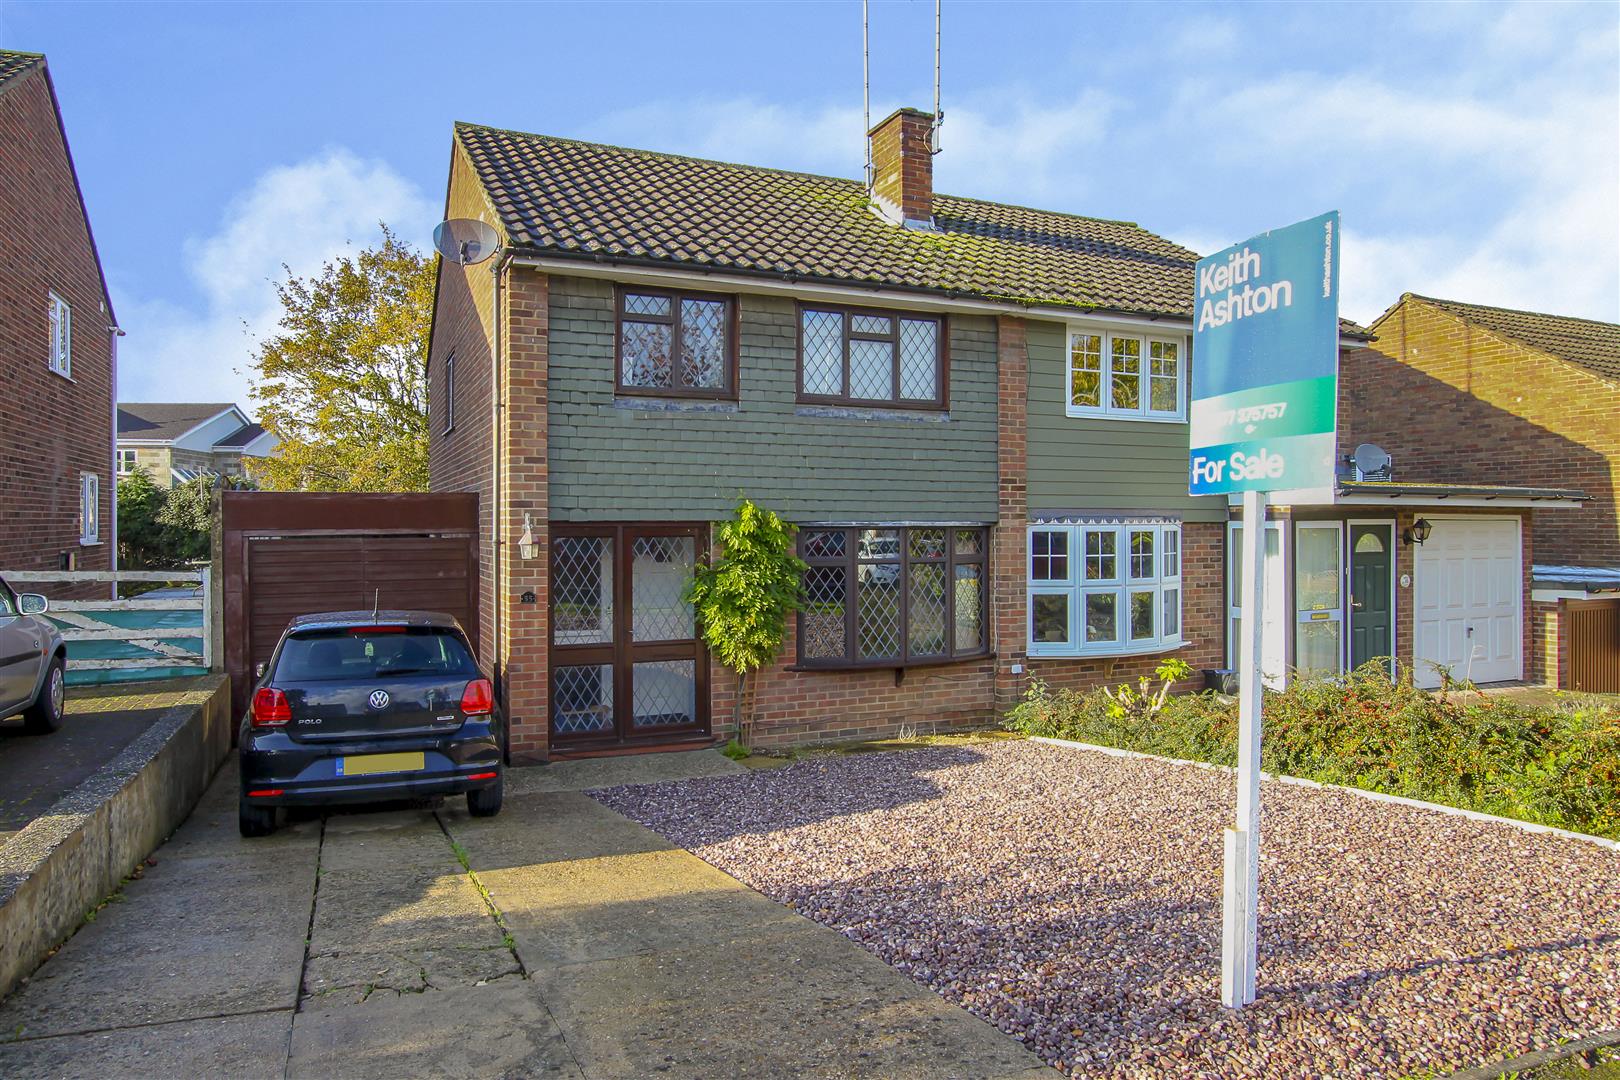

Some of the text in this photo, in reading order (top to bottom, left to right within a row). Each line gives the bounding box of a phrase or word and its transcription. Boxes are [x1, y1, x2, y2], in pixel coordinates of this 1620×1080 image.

[1199, 247, 1261, 299] Keith
[1197, 279, 1292, 333] Ashton
[1192, 447, 1285, 485] For Sale
